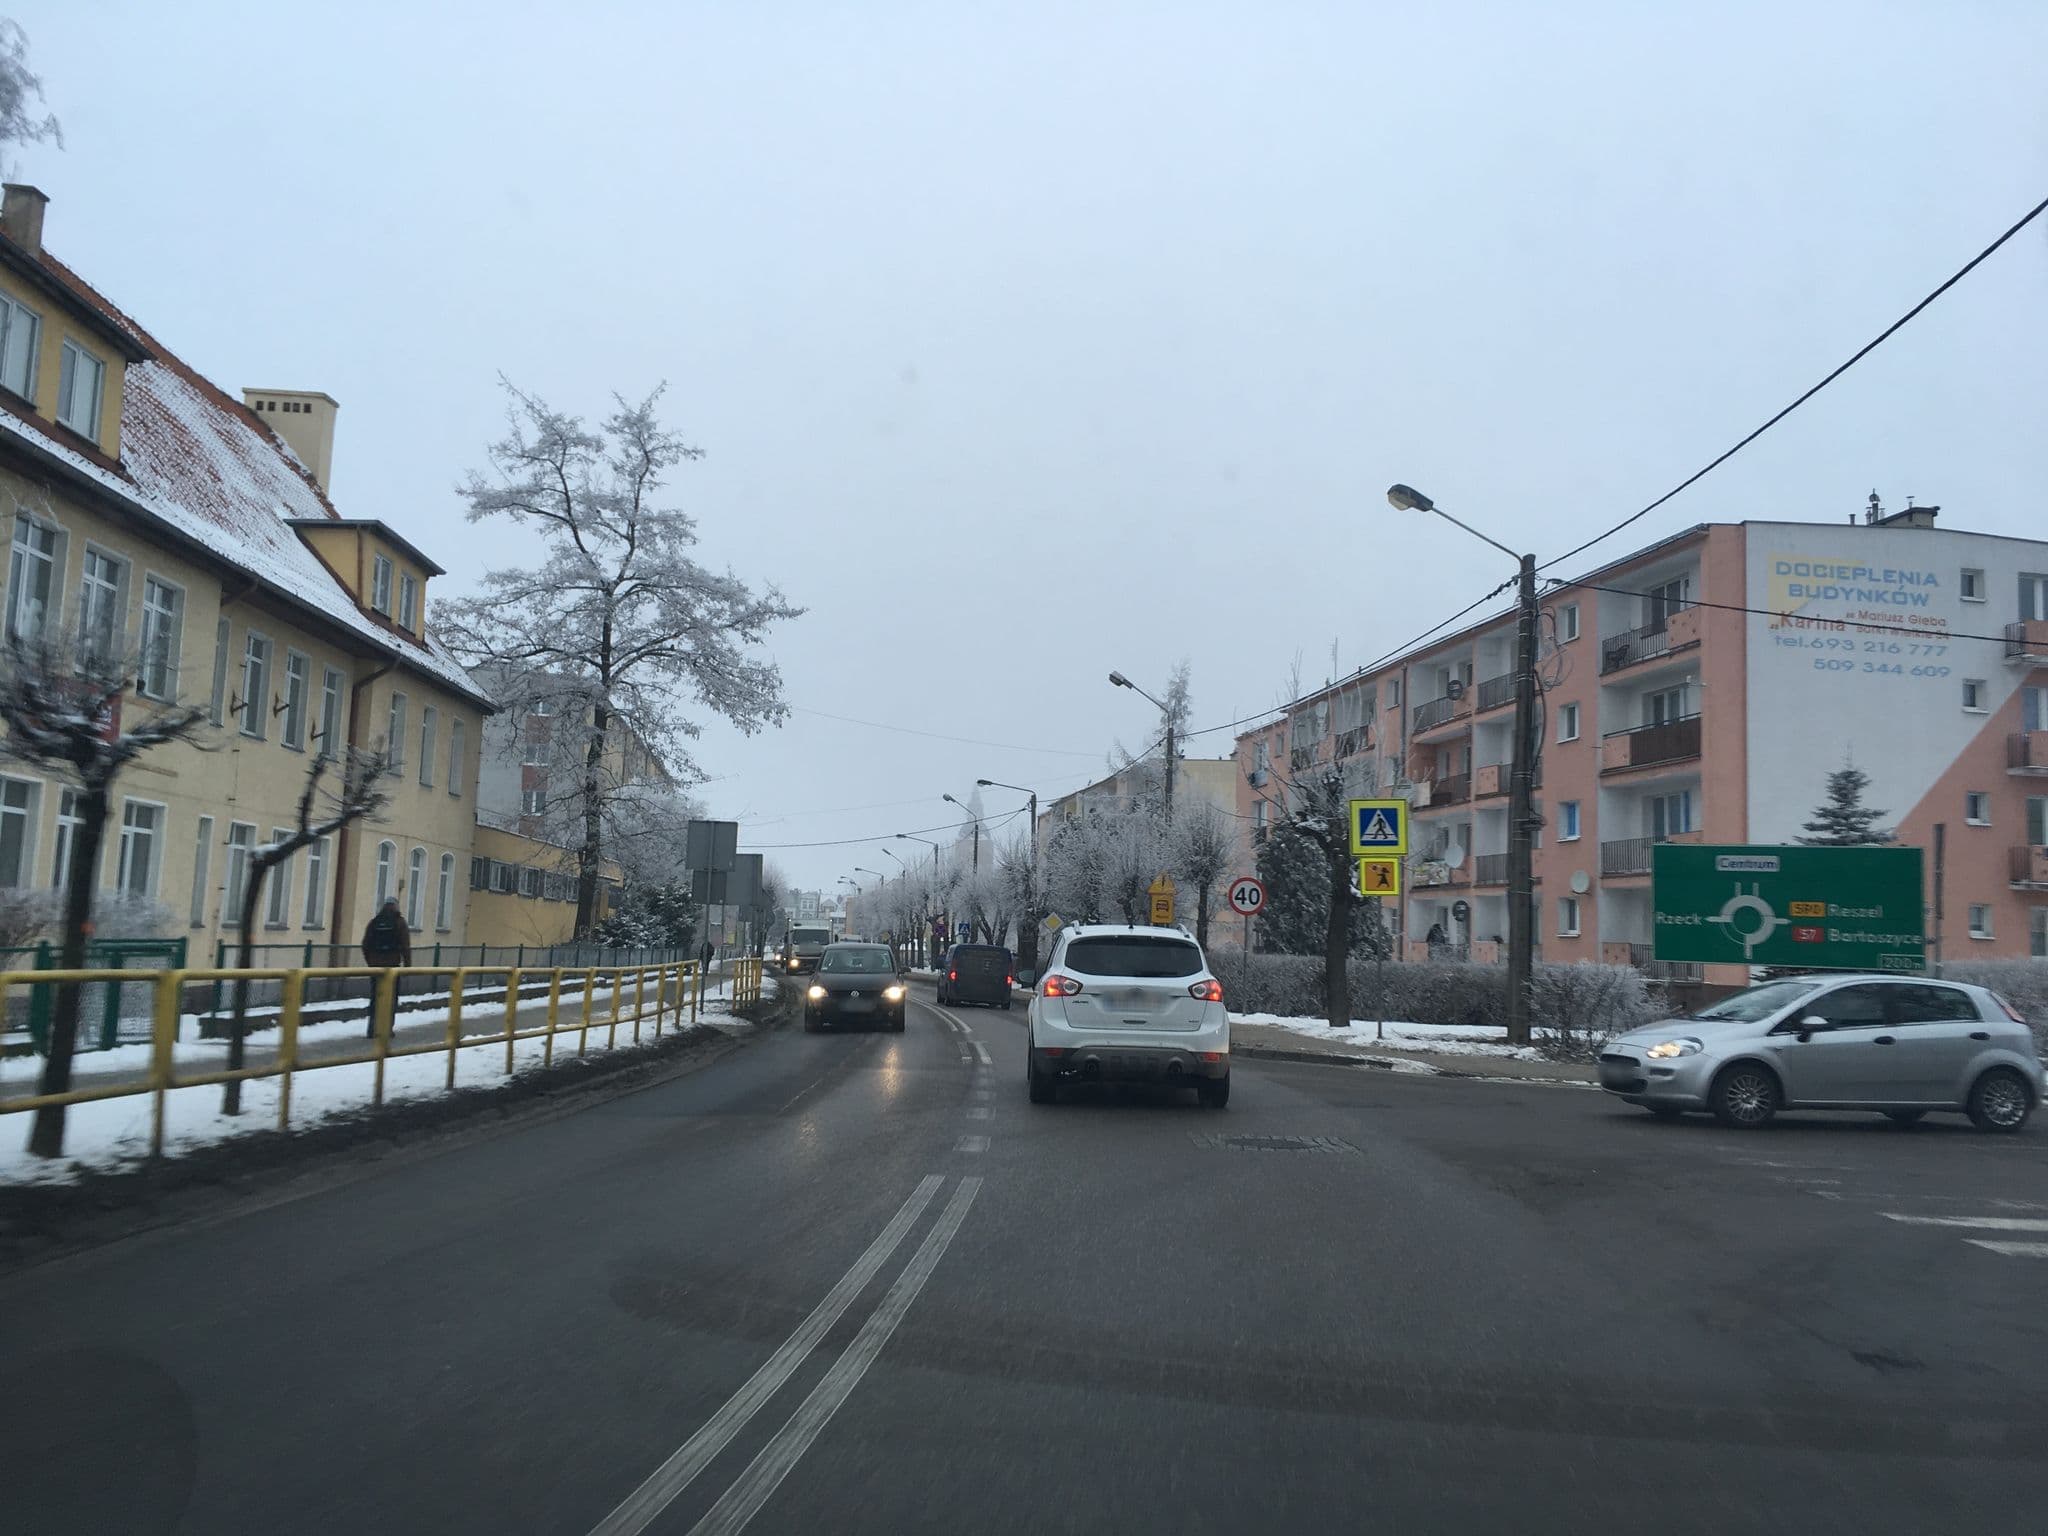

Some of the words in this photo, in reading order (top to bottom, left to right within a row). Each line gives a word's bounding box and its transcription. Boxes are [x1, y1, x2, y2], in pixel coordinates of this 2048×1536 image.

[1775, 560, 1939, 587] DOCIEPLENIA
[1788, 583, 1930, 608] BUDYNKÓW
[1858, 610, 1905, 624] Mariusz
[1863, 640, 1901, 655] 216
[1908, 644, 1948, 657] 777
[1813, 658, 1855, 672] 509
[1862, 662, 1904, 675] 344
[1910, 665, 1951, 678] 609
[1718, 857, 1778, 870] Centrum
[1235, 887, 1260, 905] 40
[1827, 903, 1884, 918] Reszel
[1827, 927, 1923, 948] Bartoszyce
